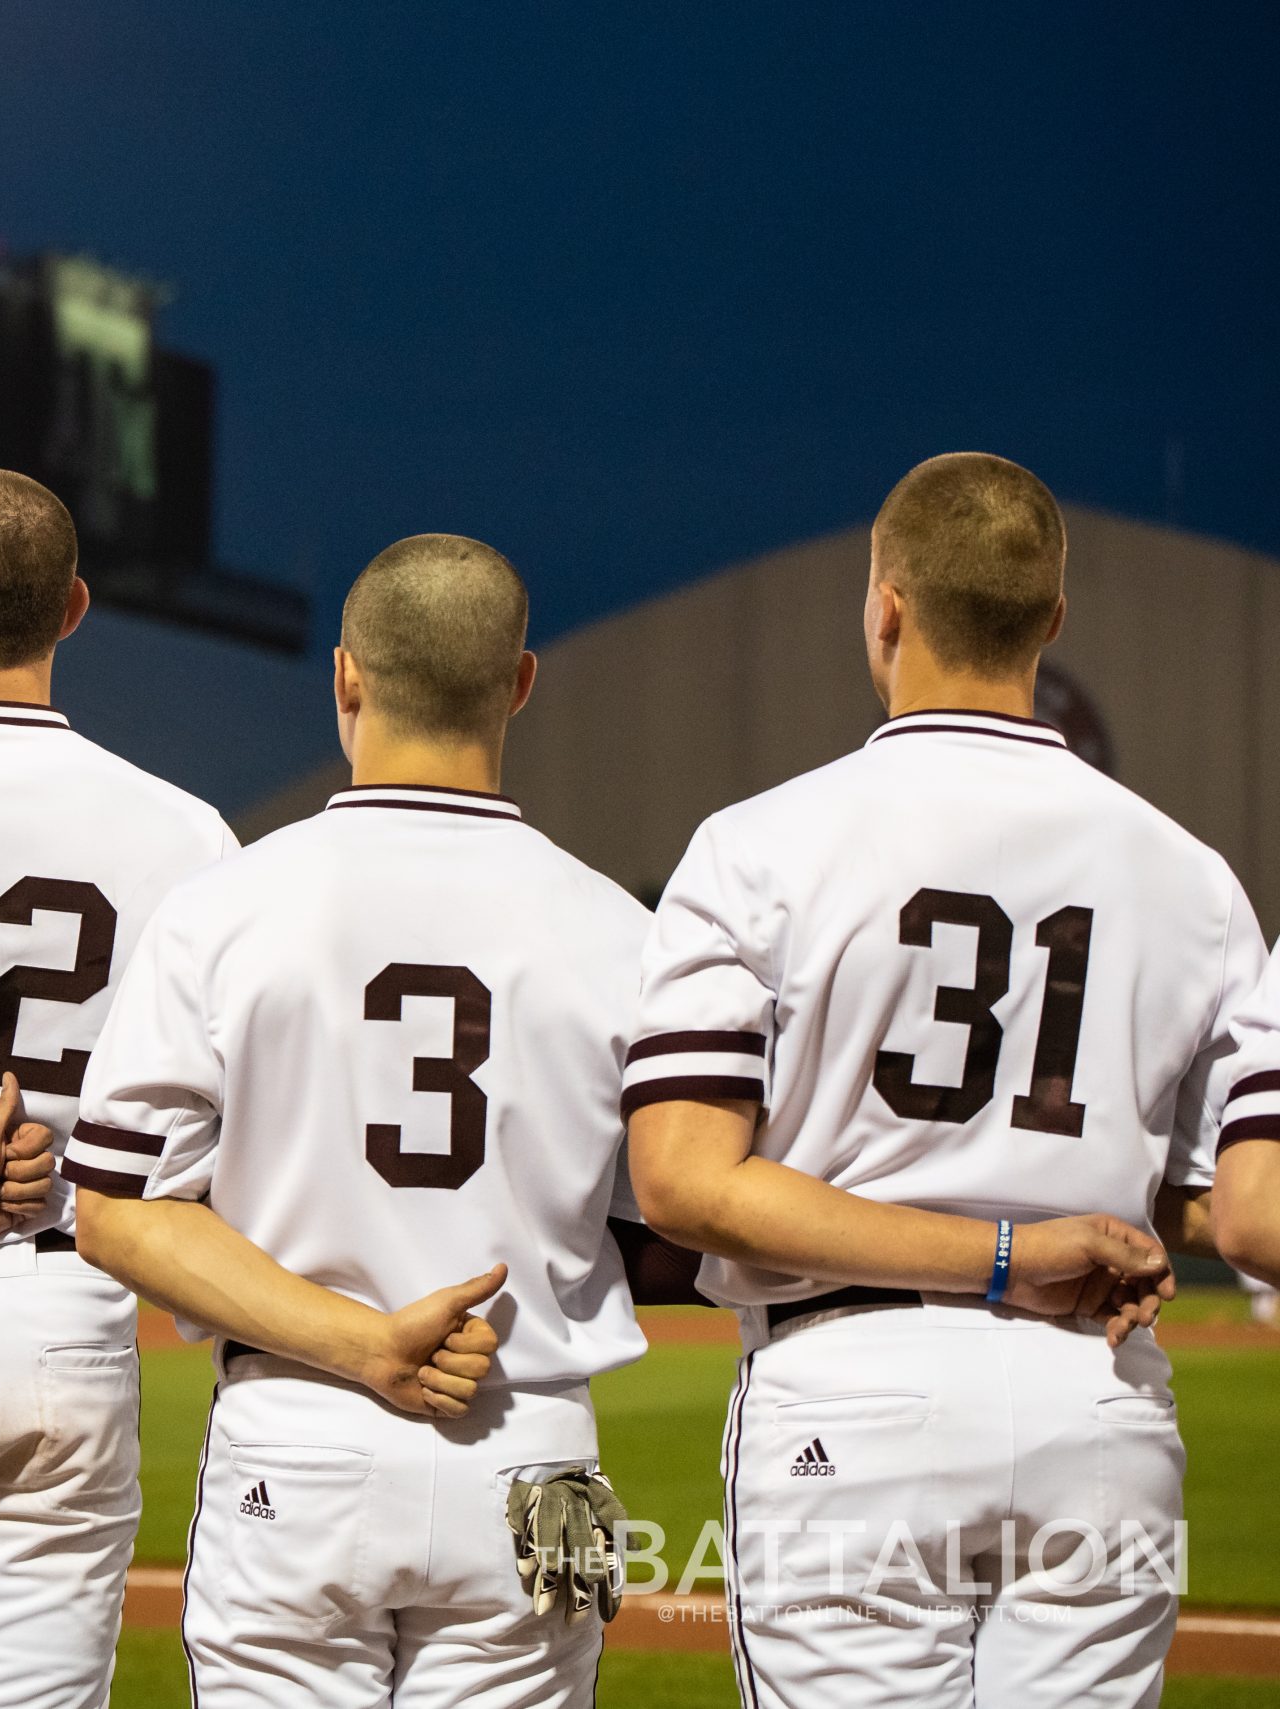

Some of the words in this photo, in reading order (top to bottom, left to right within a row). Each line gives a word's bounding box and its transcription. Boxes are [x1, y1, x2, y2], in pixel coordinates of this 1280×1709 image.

[872, 887, 1094, 1138] 31
[364, 962, 491, 1190] 3
[239, 1501, 276, 1520] adidas
[790, 1462, 836, 1476] adidas
